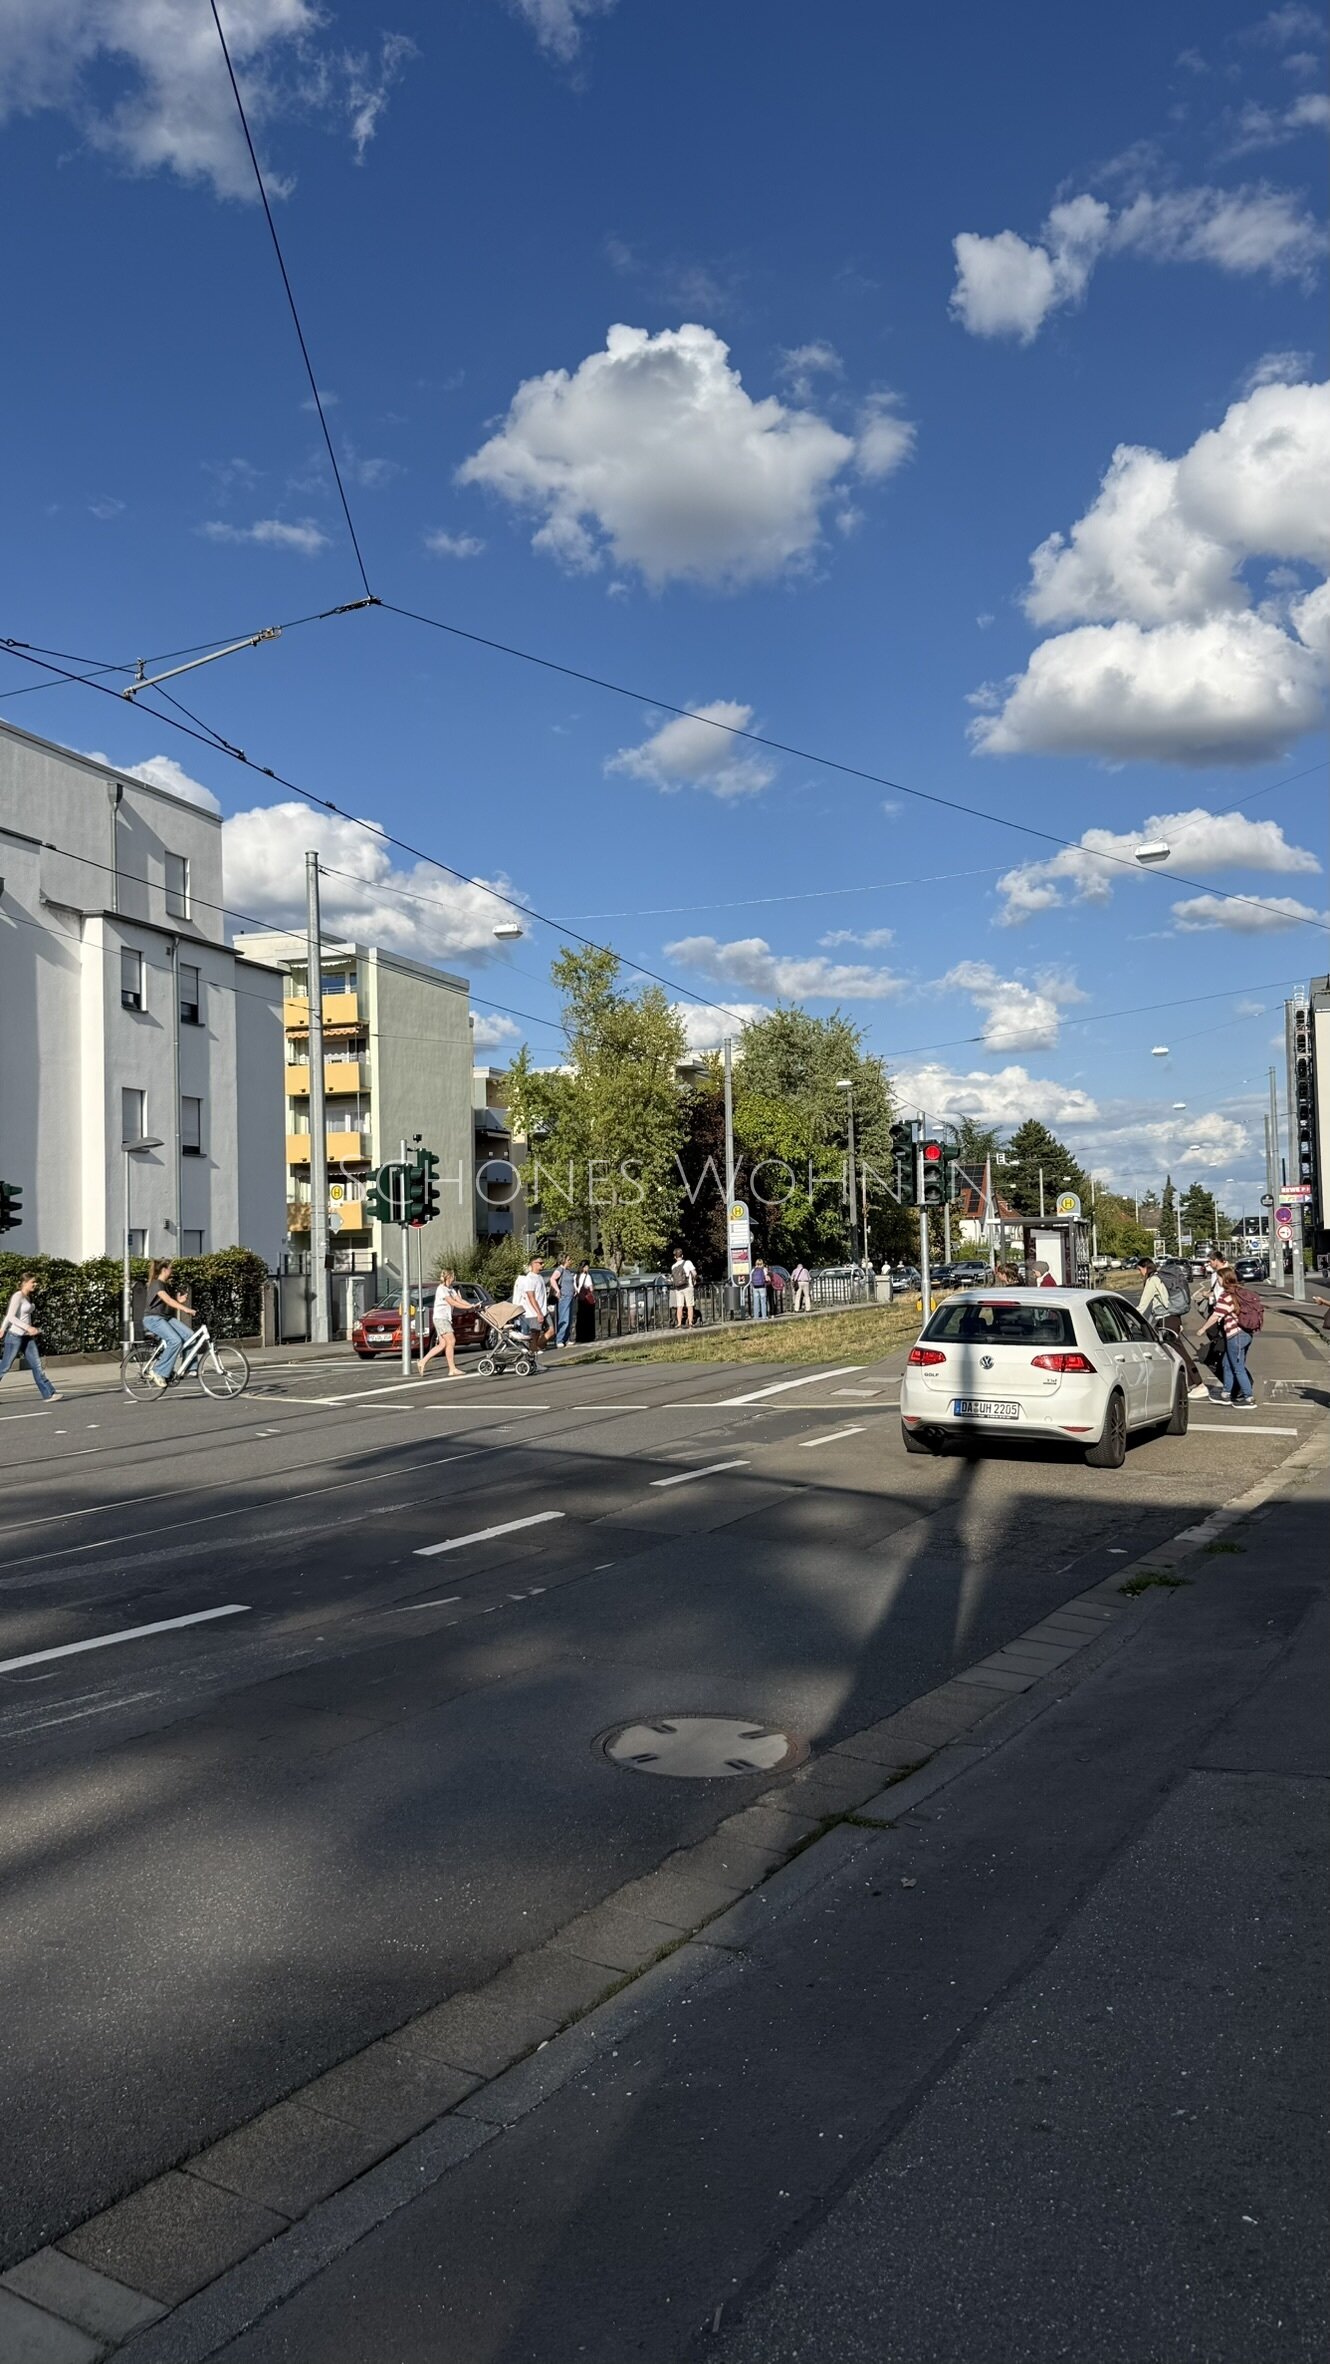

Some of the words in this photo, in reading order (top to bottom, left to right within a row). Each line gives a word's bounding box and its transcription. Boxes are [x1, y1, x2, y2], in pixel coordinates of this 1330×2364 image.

[1064, 1199, 1072, 1207] H
[961, 1401, 973, 1413] DA
[979, 1403, 992, 1414] UH
[994, 1403, 1017, 1415] 2205
